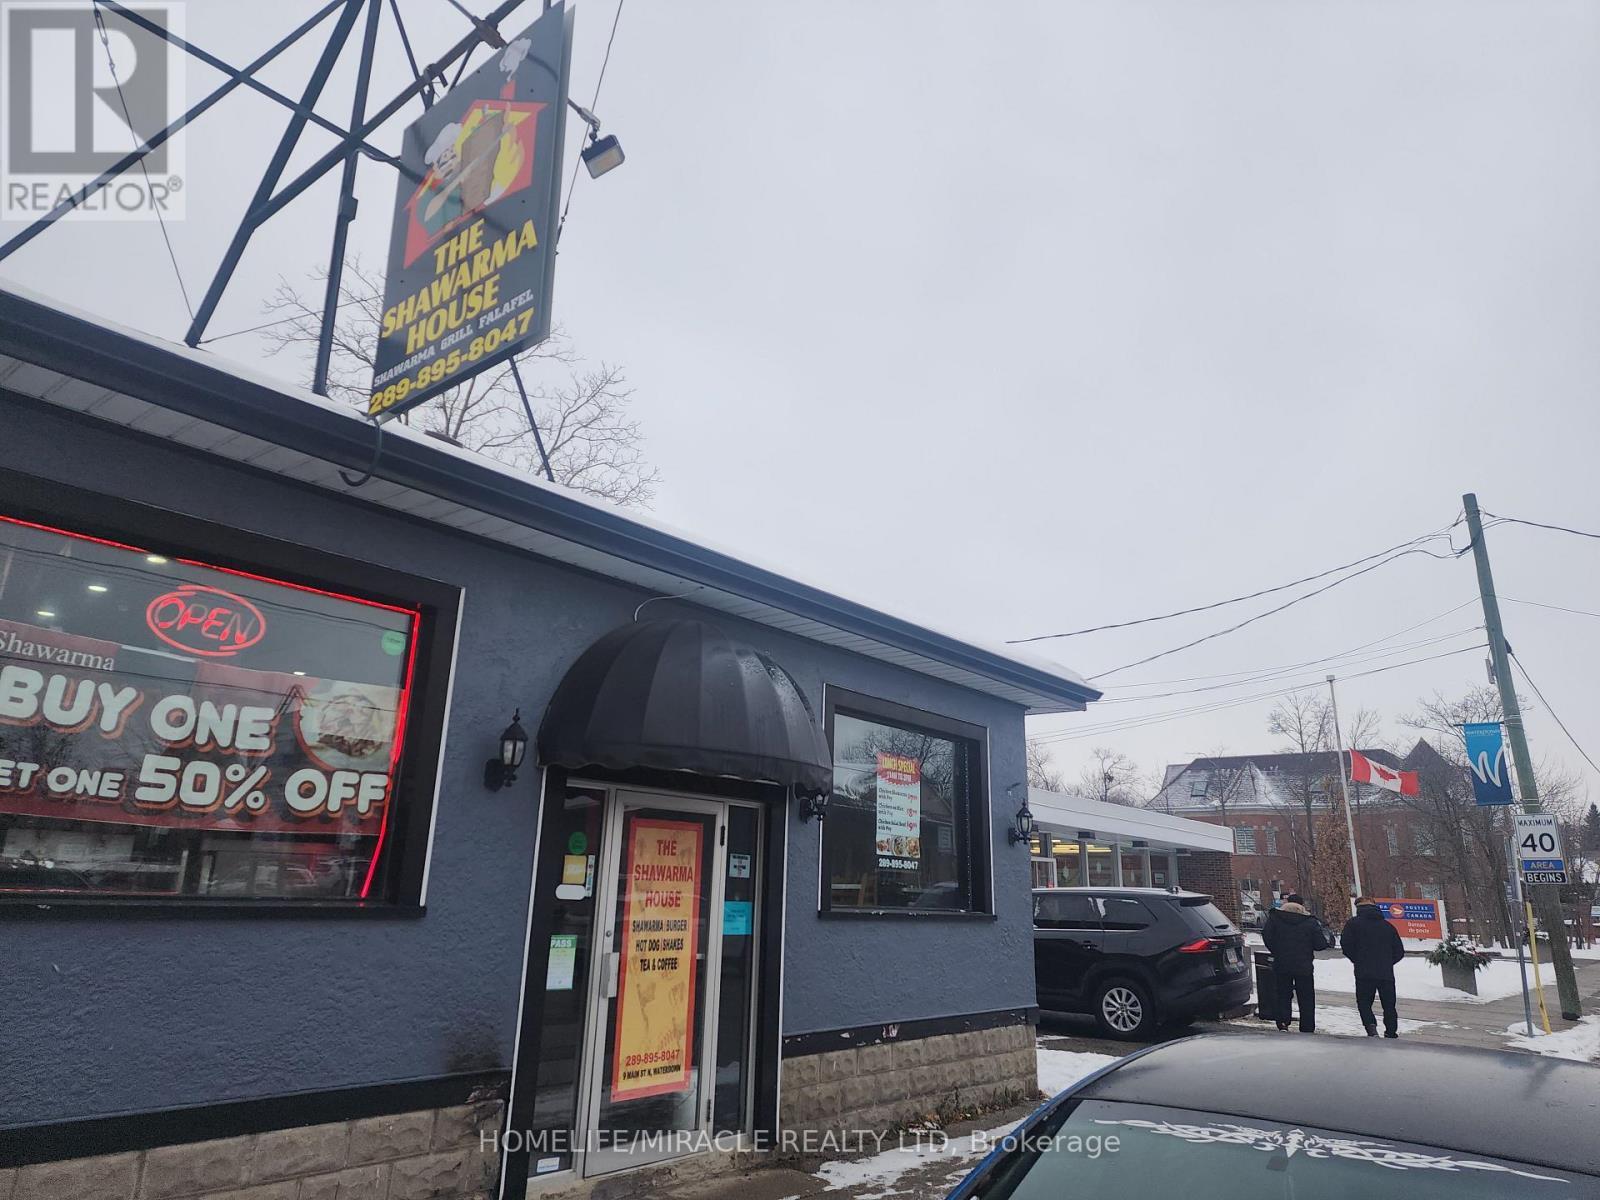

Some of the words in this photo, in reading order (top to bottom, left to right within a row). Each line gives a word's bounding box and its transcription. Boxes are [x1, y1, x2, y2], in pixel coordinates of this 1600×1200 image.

[434, 218, 485, 275] THE
[382, 219, 538, 339] SHAWARMA
[406, 275, 500, 355] HOUSE
[374, 346, 436, 388] SHAWARMA
[440, 324, 474, 350] GRILL
[478, 288, 534, 330] FALAFEL
[368, 307, 535, 415] 289-895-8047
[153, 596, 256, 644] OPEN
[0, 630, 115, 672] Shawarma
[0, 665, 140, 733] BUY
[151, 694, 277, 752] ONE
[47, 769, 125, 799] ONE
[135, 754, 268, 811] 50%
[285, 768, 389, 815] OFF
[1517, 819, 1553, 827] MAXIMUM
[656, 839, 678, 857] THE
[1521, 832, 1555, 853] 40
[878, 858, 918, 869] 289-895-8047
[1530, 862, 1555, 870] AREA
[634, 864, 693, 882] SHAWARMA
[1527, 872, 1563, 883] BEGINS
[645, 890, 682, 908] HOUSE
[632, 919, 664, 933] SHAWARMA
[666, 919, 688, 933] BURGER
[550, 938, 572, 949] PASS
[636, 939, 647, 952] HOT
[648, 938, 660, 952] DOG
[662, 938, 684, 952] SHAKES
[640, 958, 650, 972] TEA
[657, 957, 678, 971] COFFEE
[625, 1049, 680, 1066] 289-895-8047
[640, 1069, 646, 1078] ST
